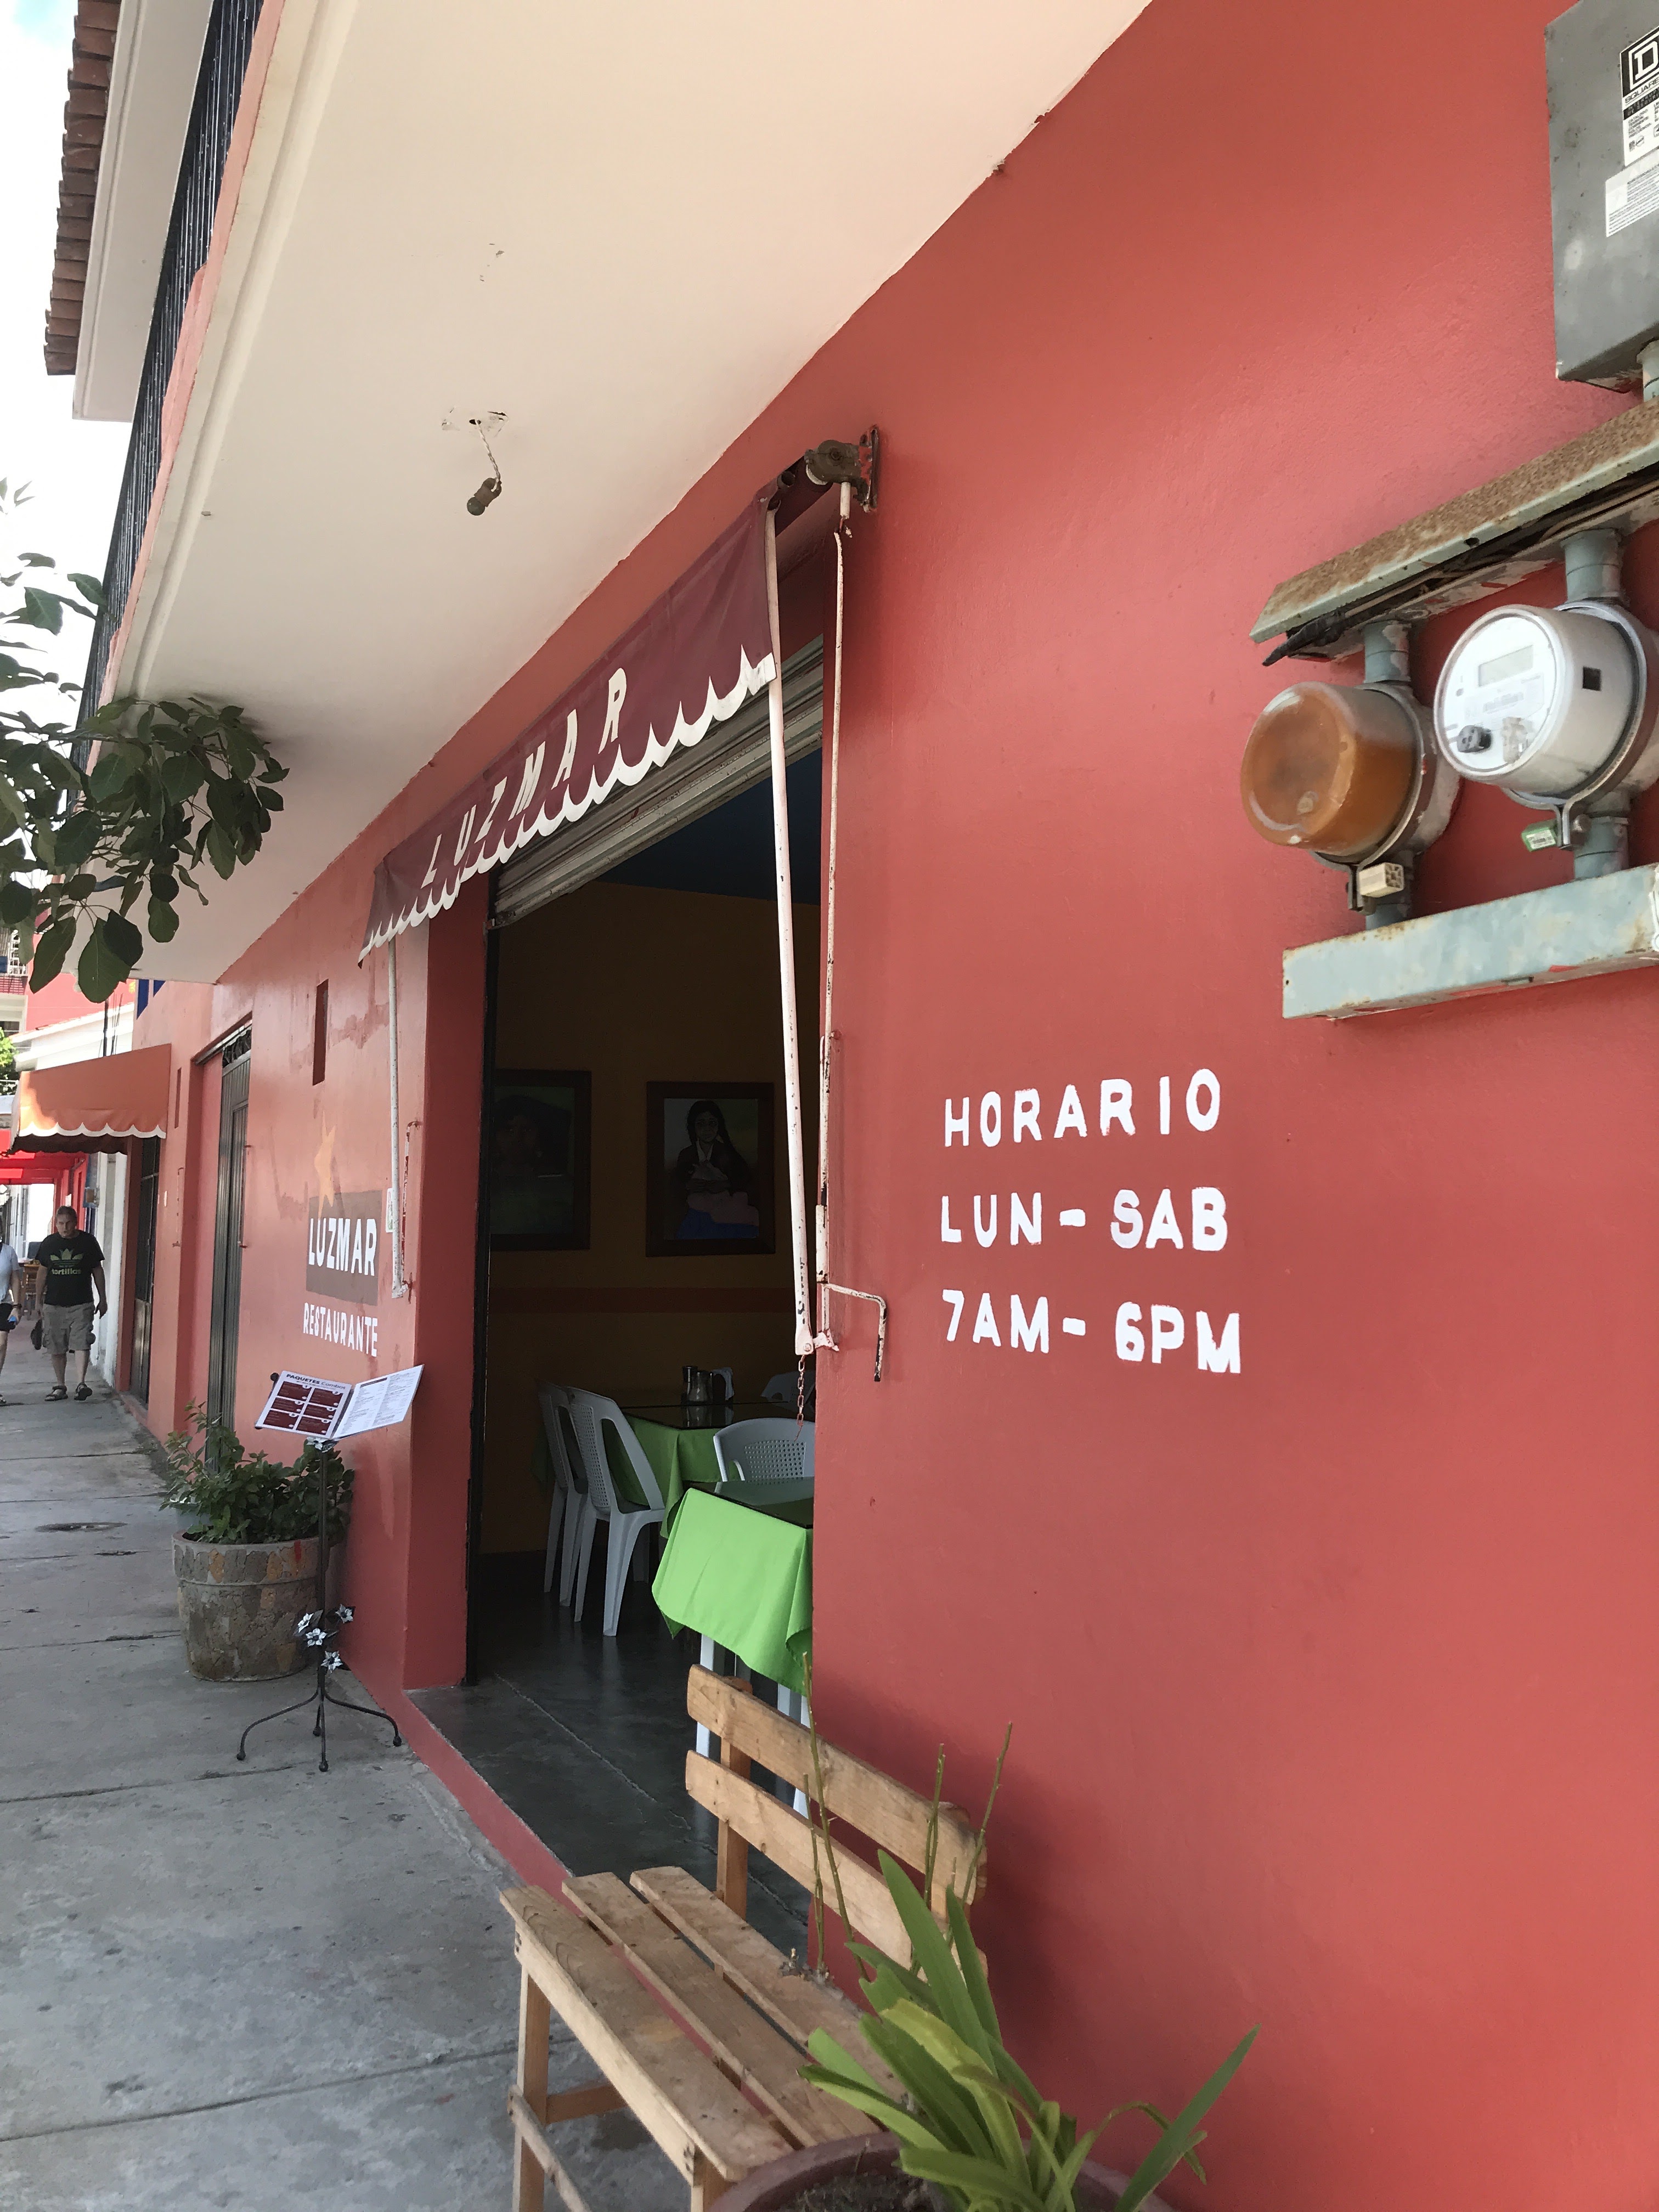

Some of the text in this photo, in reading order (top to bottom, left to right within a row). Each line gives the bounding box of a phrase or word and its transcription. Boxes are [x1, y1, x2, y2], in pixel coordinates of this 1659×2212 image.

[1625, 76, 1659, 103] SQUARE
[1634, 41, 1658, 80] D
[421, 668, 627, 889] LUZMAR
[945, 1068, 1221, 1147] HORARIO
[308, 1218, 377, 1277] LUZMAR
[1110, 1187, 1228, 1251] SAB
[303, 1302, 378, 1357] RESTAURANTE
[1115, 1301, 1241, 1374] 6PM
[286, 1374, 320, 1384] PAQUETES
[321, 1381, 346, 1390] Combos
